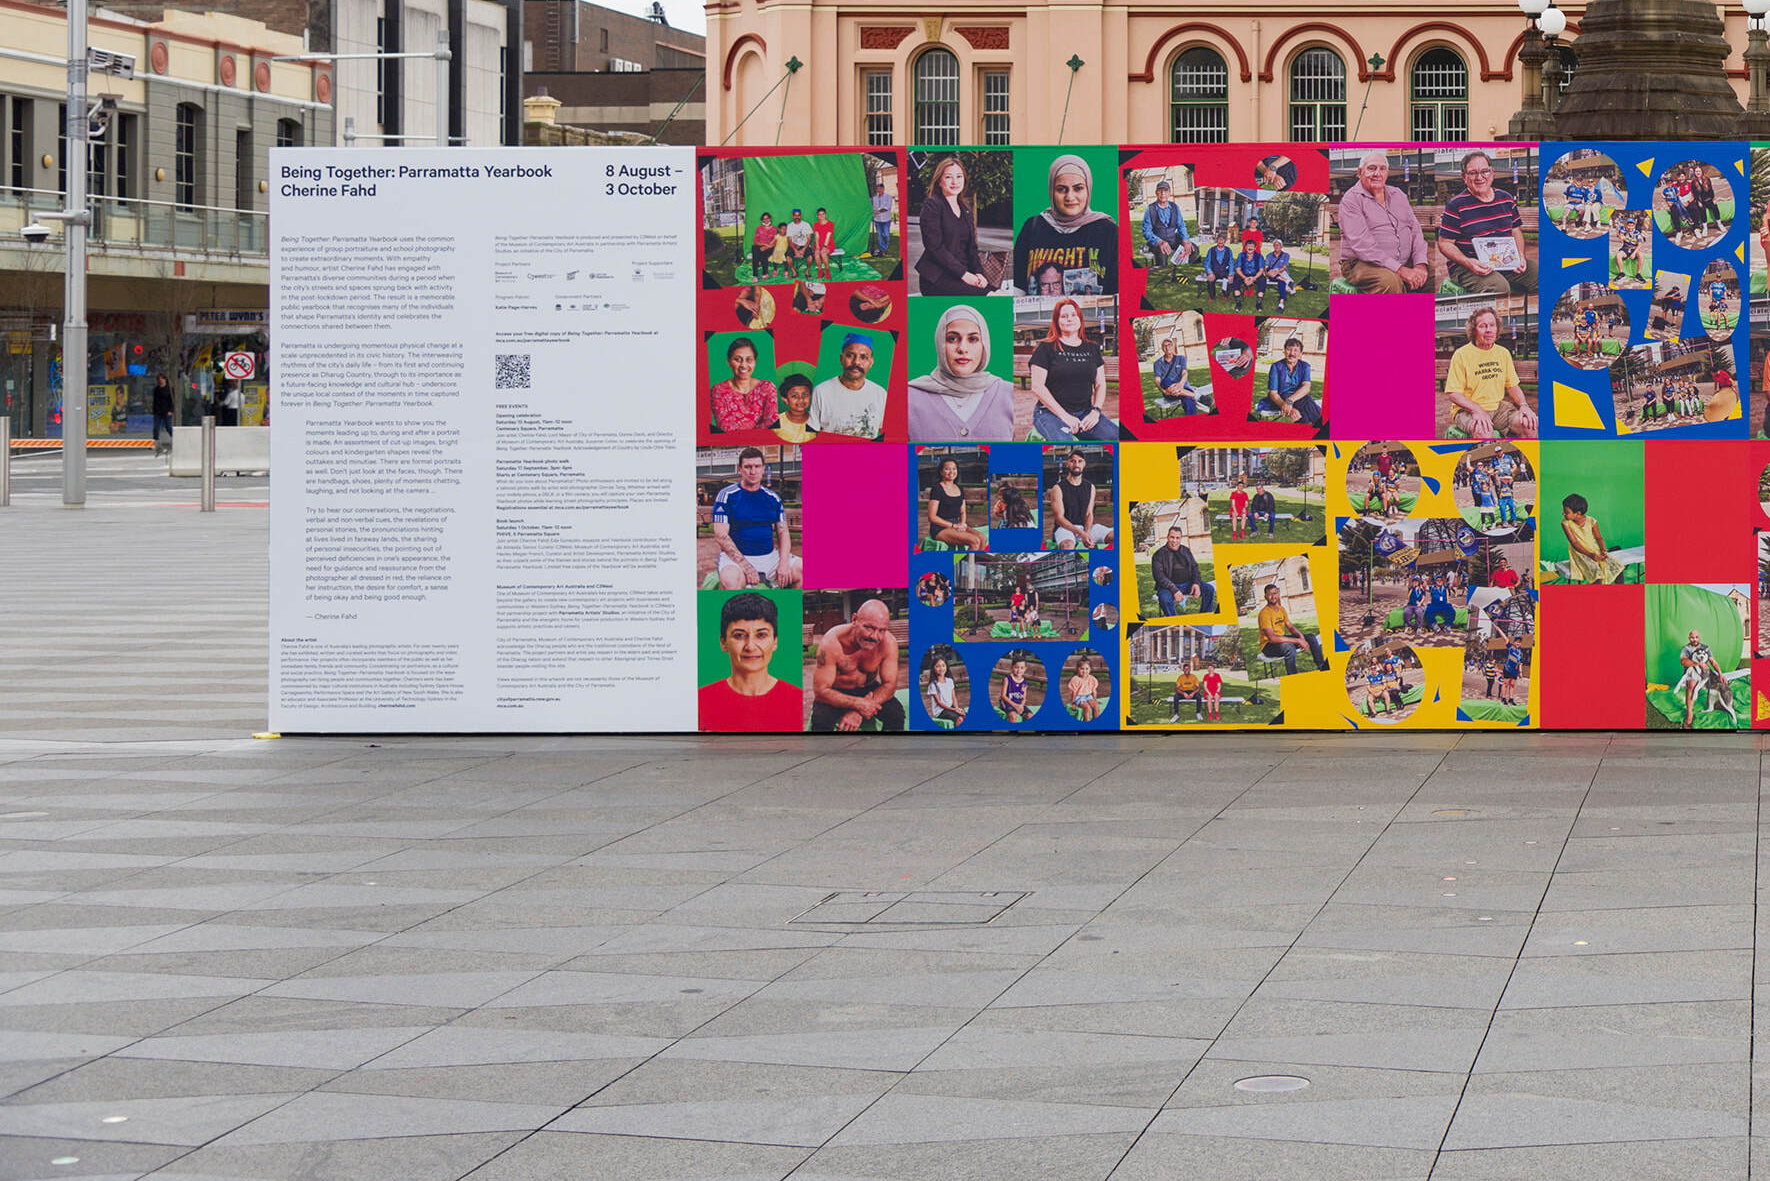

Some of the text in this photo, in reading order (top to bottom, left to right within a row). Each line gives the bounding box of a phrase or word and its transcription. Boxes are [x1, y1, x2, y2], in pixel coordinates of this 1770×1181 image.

[281, 164, 552, 181] Being Together: Parramatta Yearbook
[605, 164, 615, 177] 8
[618, 165, 671, 180] August
[281, 184, 376, 197] Cherine Fahd
[605, 182, 677, 195] 3 October
